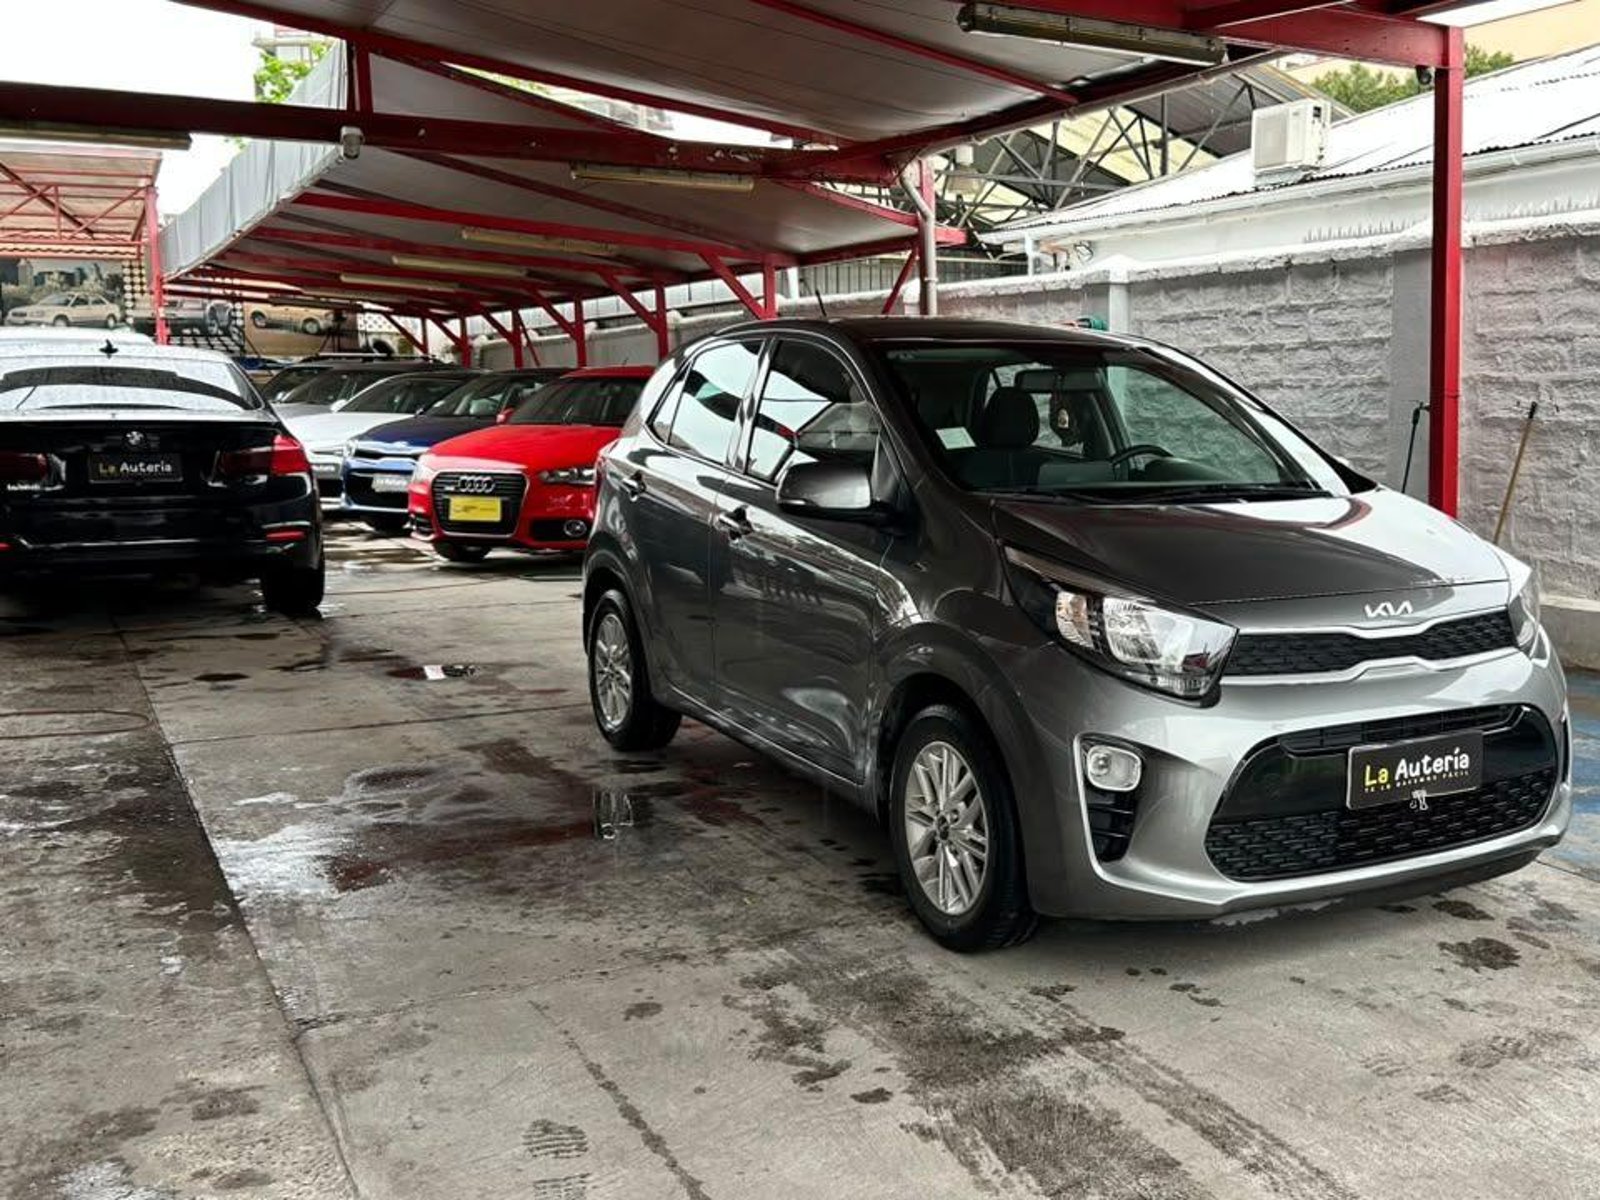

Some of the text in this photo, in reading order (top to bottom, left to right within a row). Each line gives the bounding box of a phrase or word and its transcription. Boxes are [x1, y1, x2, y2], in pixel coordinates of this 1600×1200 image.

[1364, 600, 1413, 618] KIA
[1364, 764, 1390, 786] La
[1394, 747, 1470, 781] Autería
